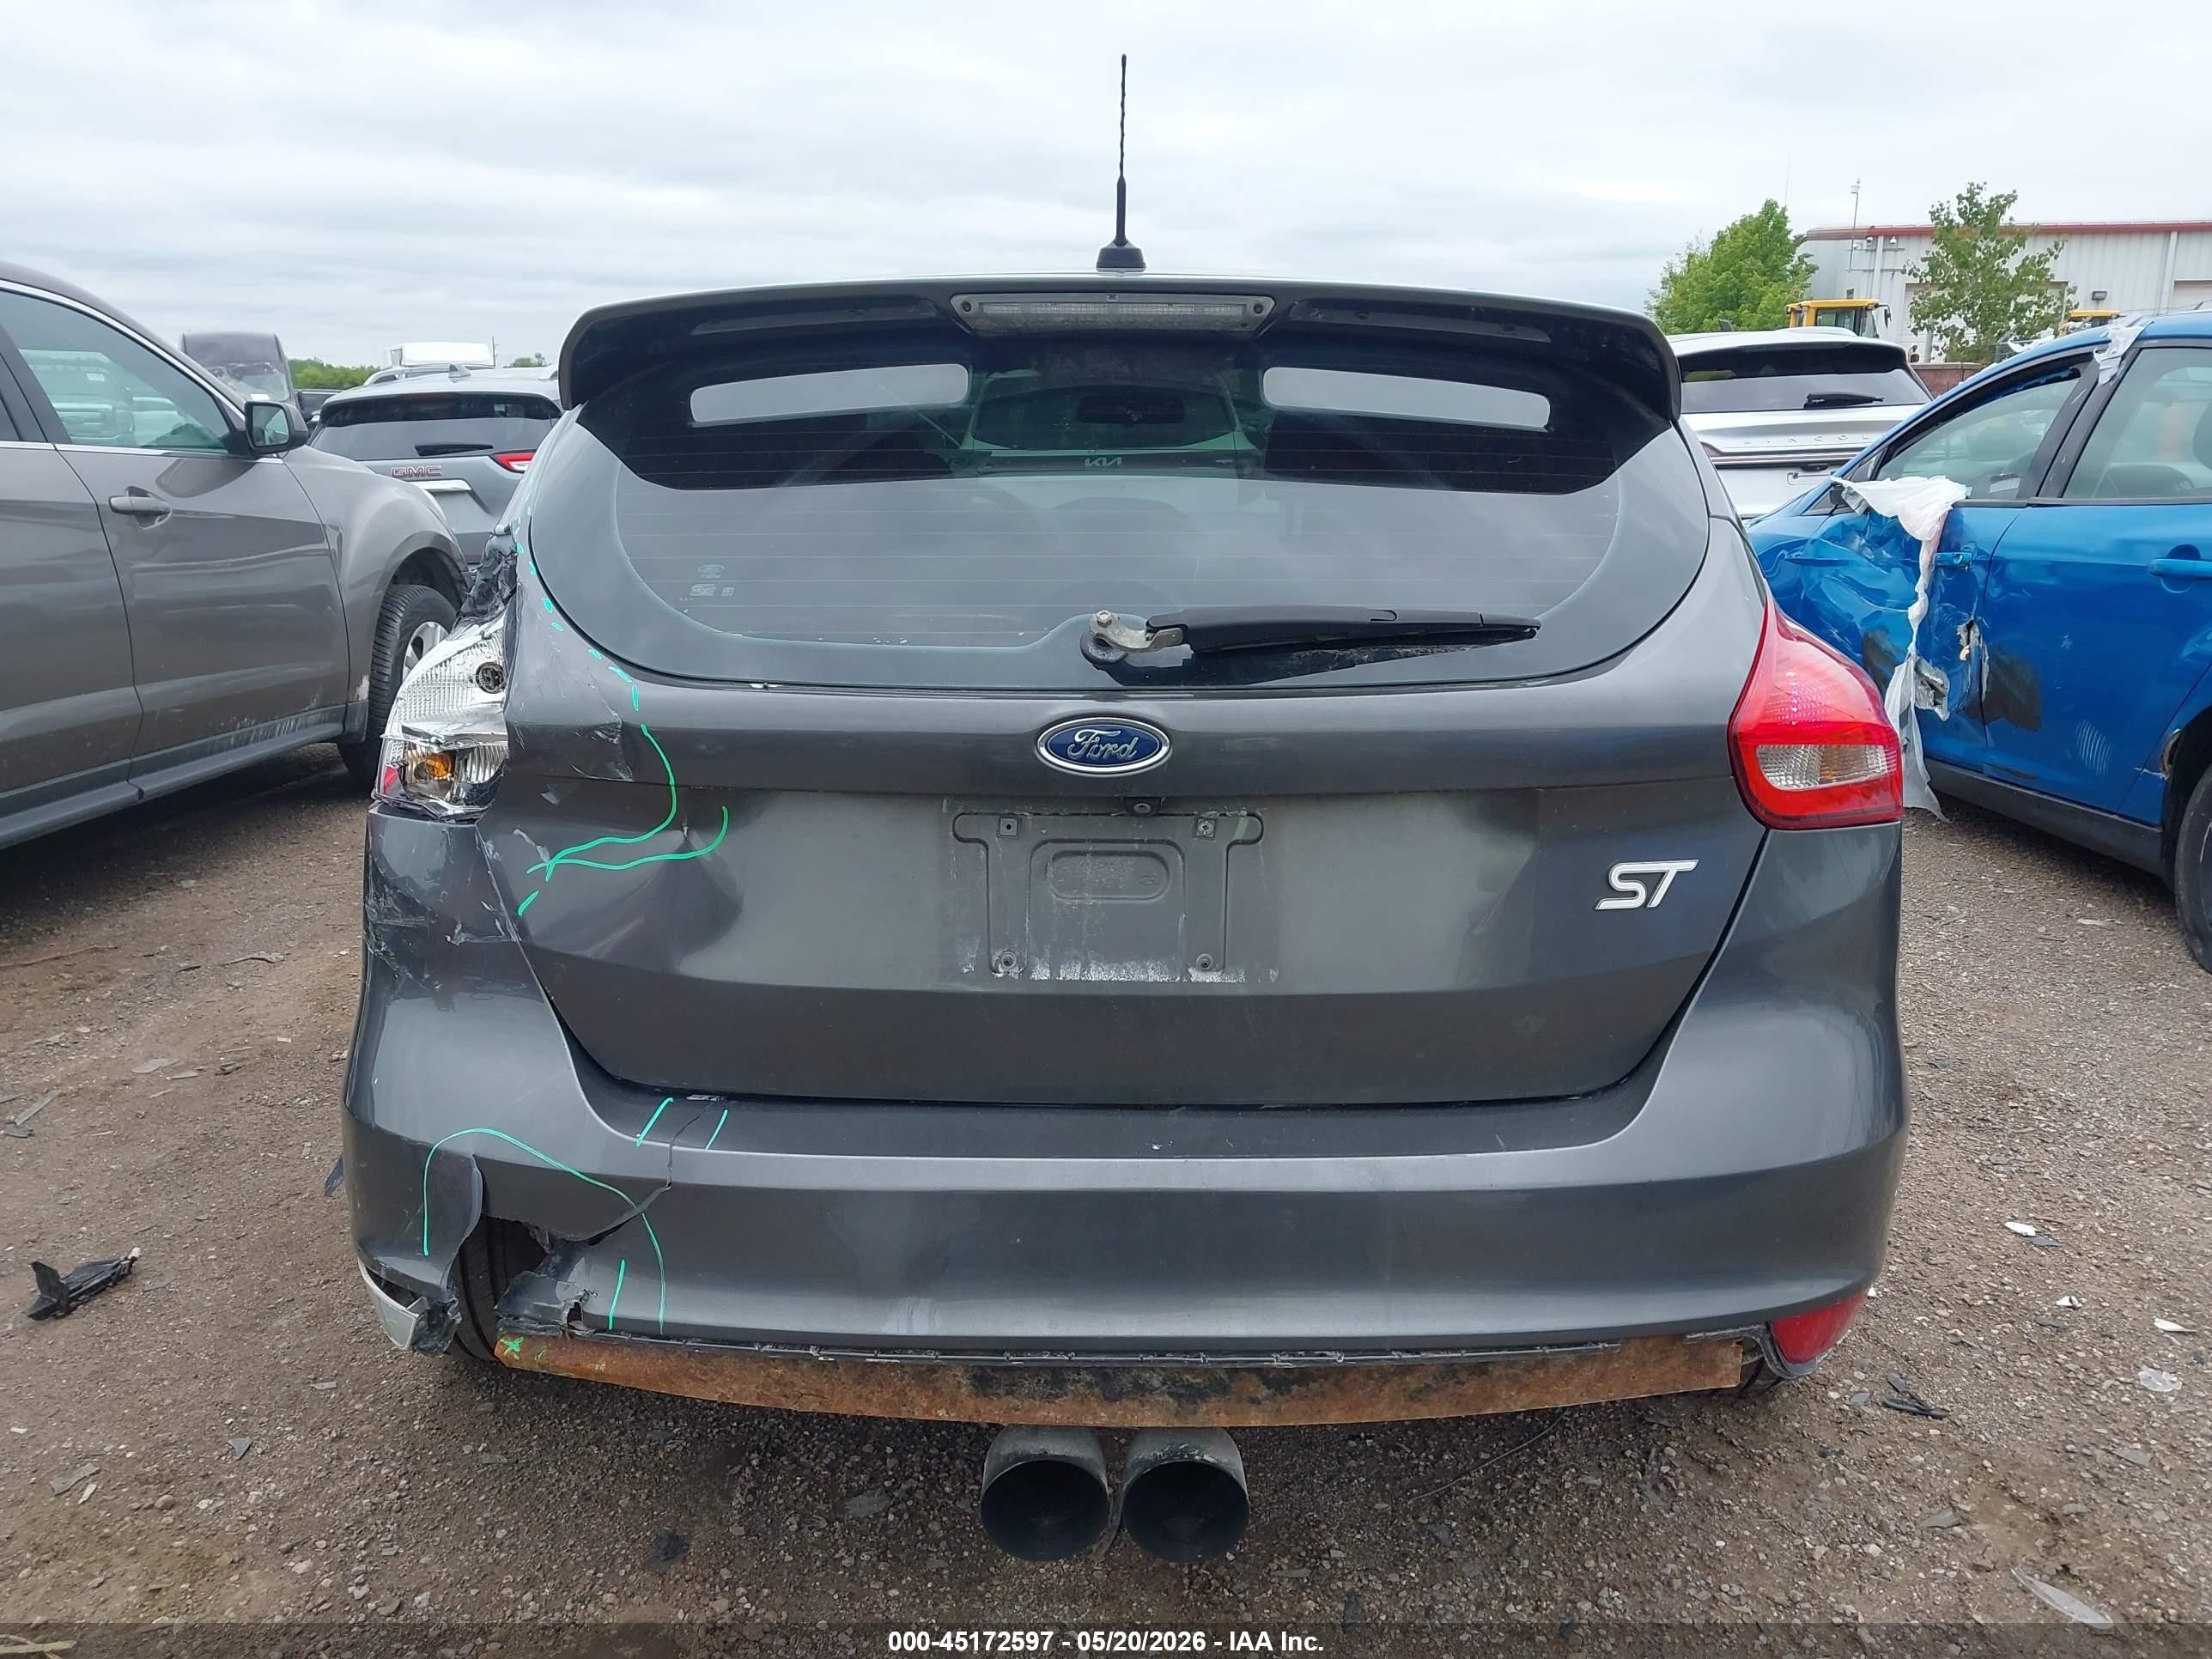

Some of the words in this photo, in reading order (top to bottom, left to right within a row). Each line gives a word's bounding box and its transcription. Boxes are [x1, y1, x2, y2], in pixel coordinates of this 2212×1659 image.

[1742, 432, 1886, 445] LINCOL
[391, 465, 441, 477] GMC
[1067, 728, 1139, 759] Ford
[1595, 859, 1700, 910] ST
